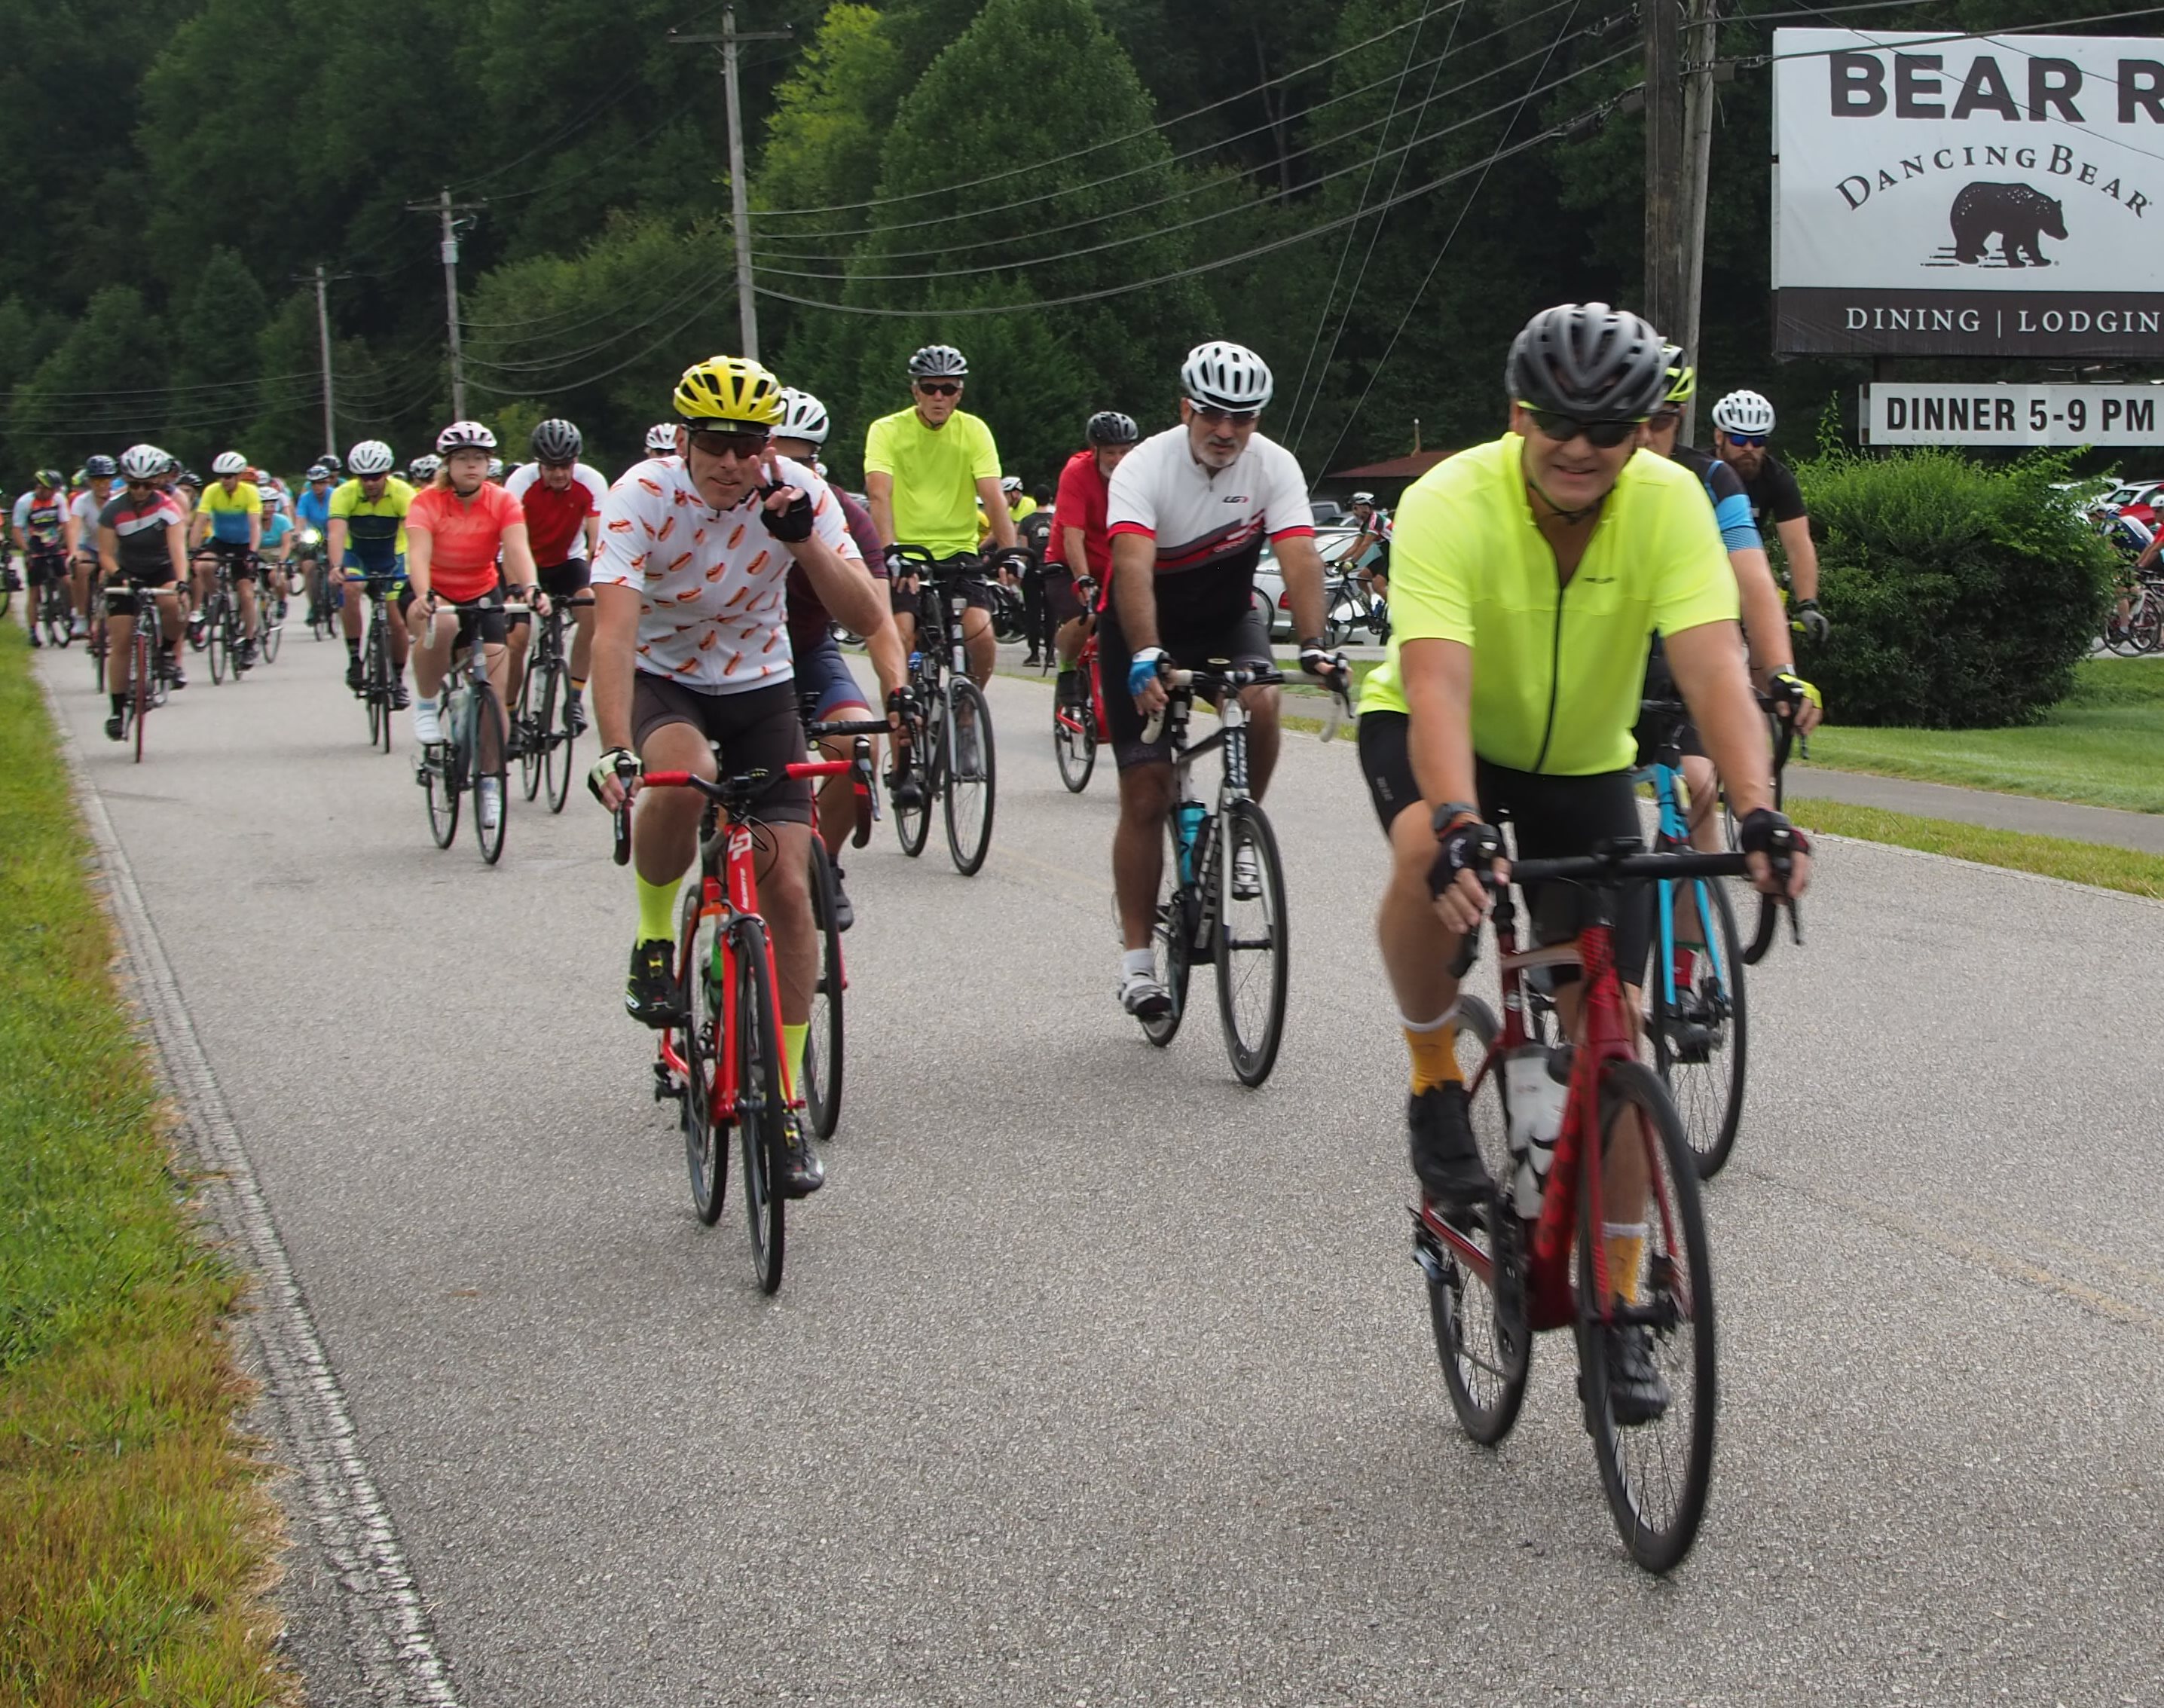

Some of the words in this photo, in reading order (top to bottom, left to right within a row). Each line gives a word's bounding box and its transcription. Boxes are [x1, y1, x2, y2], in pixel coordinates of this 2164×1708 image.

[1829, 53, 2086, 122] BEAR
[1846, 307, 1980, 332] DINING
[2018, 310, 2161, 333] LODGIN
[1887, 397, 2016, 431] DINNER
[2029, 399, 2086, 432] 5-9
[2102, 399, 2154, 432] PM
